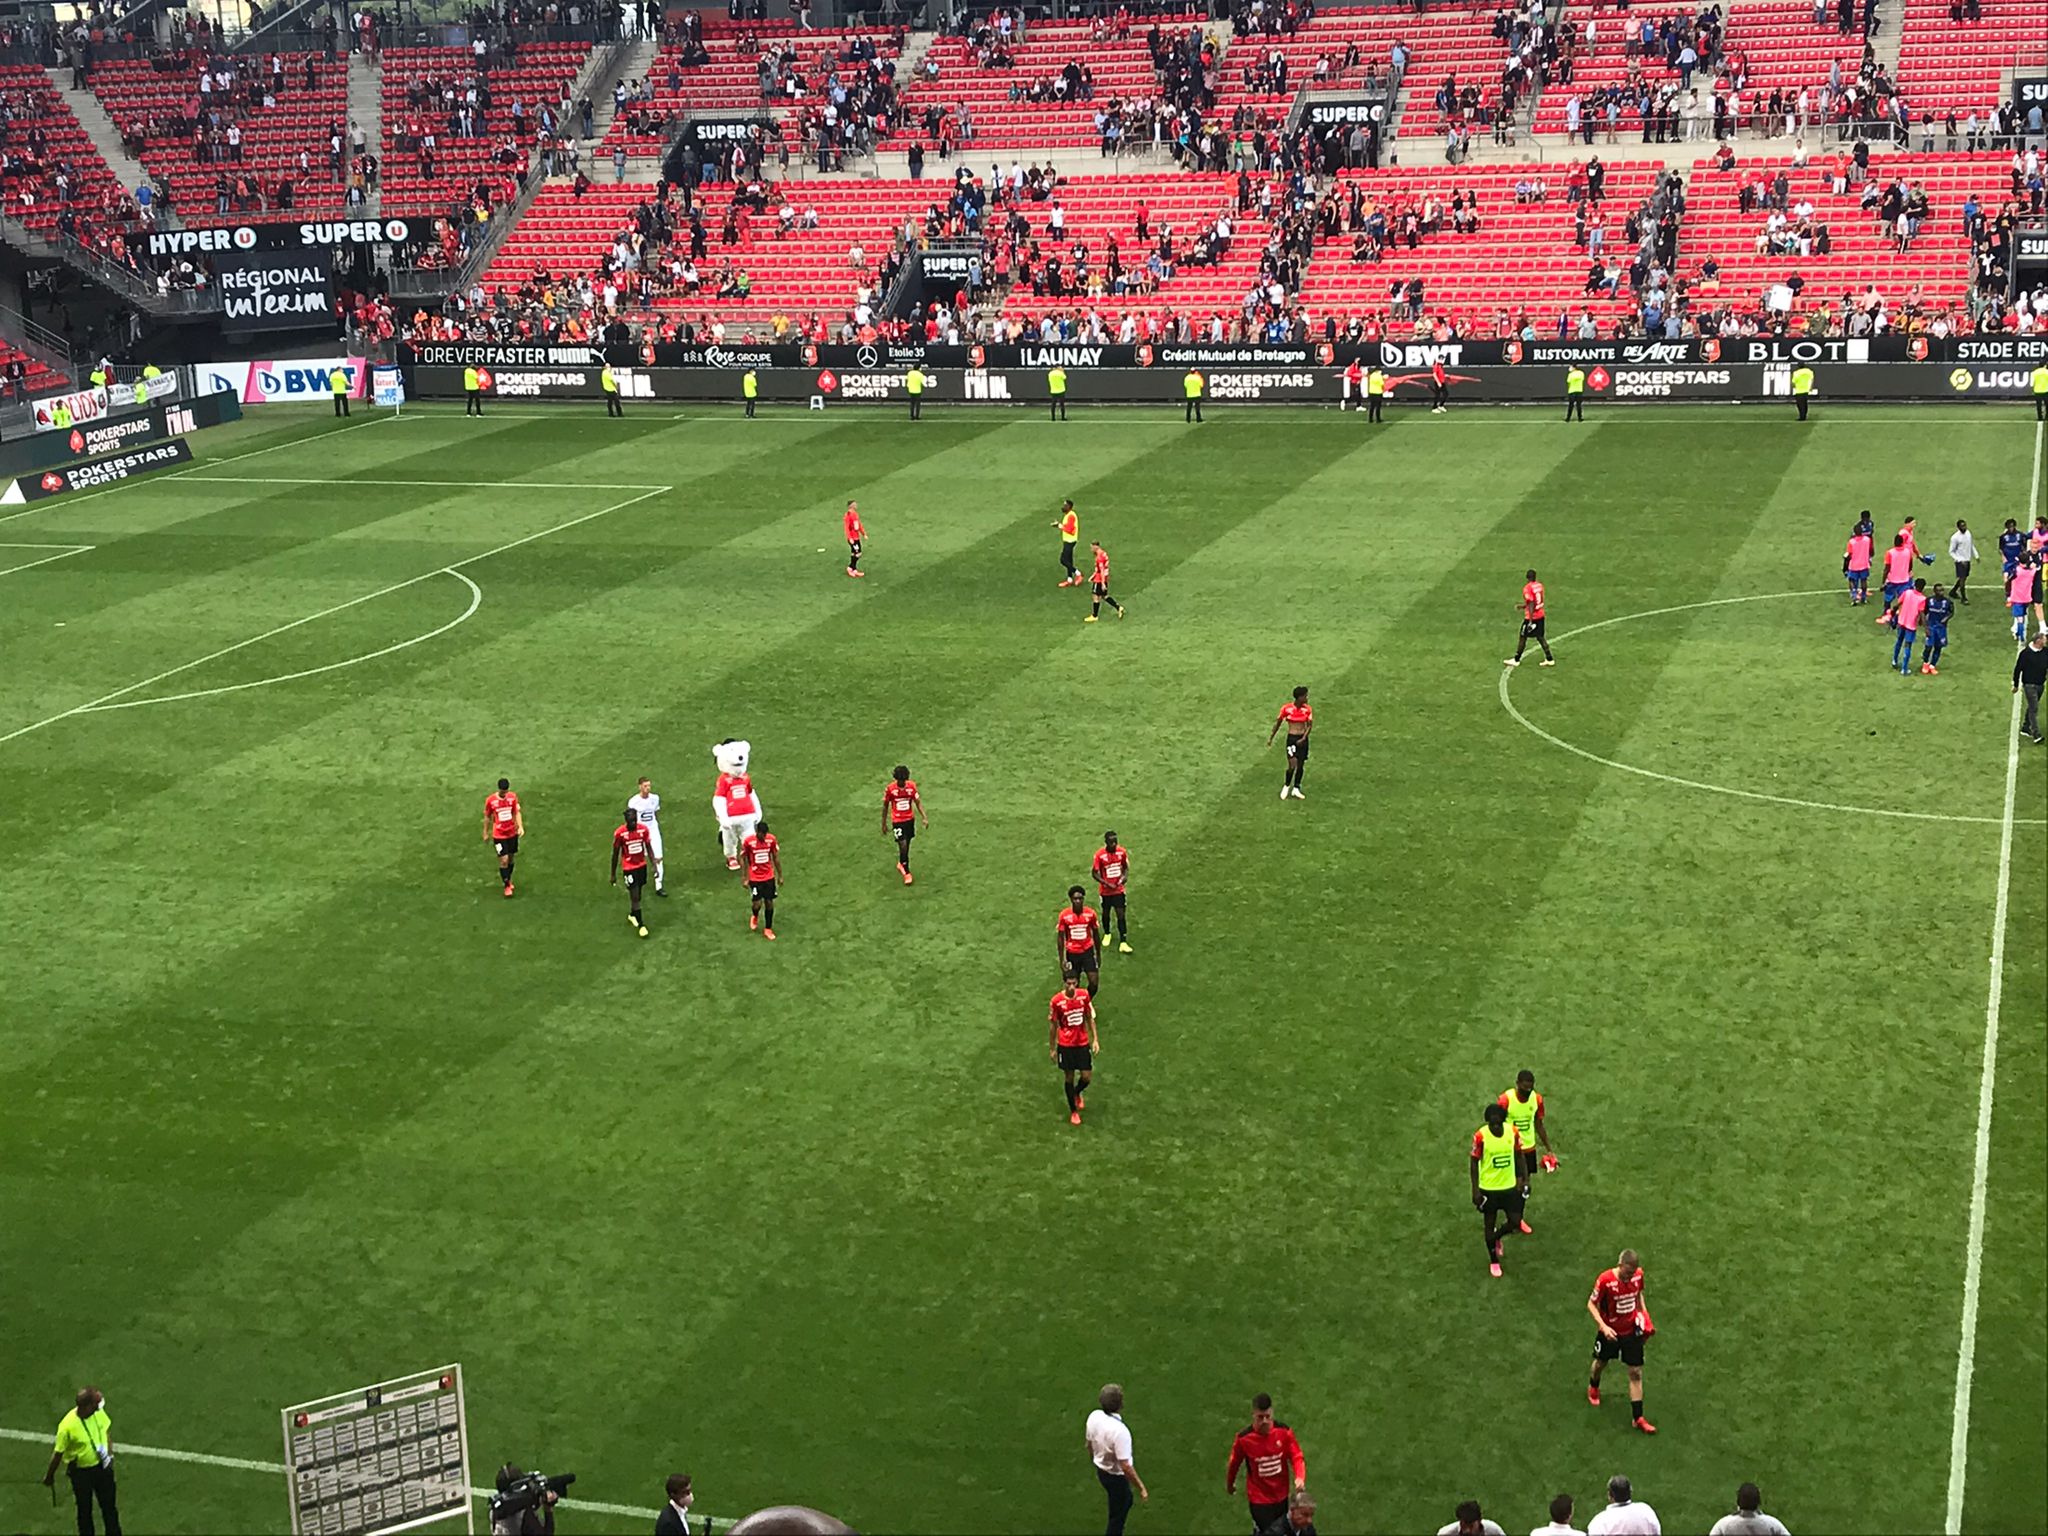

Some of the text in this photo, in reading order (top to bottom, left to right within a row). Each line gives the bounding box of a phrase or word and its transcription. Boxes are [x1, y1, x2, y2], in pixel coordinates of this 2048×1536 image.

[1312, 106, 1369, 123] SUPER
[696, 124, 747, 139] SUPER
[300, 221, 382, 245] SUPER
[150, 229, 231, 255] HYPER
[2021, 239, 2048, 254] SU
[923, 257, 967, 271] SUPER
[222, 265, 326, 289] RÉGIONAL
[224, 282, 328, 319] interim
[737, 352, 772, 362] GROUPE
[1162, 349, 1306, 364] Crédit Mutuel de Bretagne
[1405, 344, 1463, 366] BWT
[1533, 348, 1616, 361] RISTORANTE
[1748, 341, 1846, 361] BLOT
[1957, 341, 2014, 358] STADE
[495, 372, 586, 386] POKERSTARS
[841, 374, 937, 388] POKERSTRS
[1209, 374, 1314, 388] POKERSTARS
[1615, 370, 1730, 384] POKERSTARS
[496, 385, 541, 396] SPORTS
[841, 387, 889, 398] SPORTS
[1209, 387, 1260, 398] SPORTS
[1615, 384, 1671, 396] SPORTS
[85, 417, 150, 444] POKERSTARS
[87, 439, 121, 455] SPORTS
[66, 445, 179, 482] POKERSTARS
[70, 469, 128, 491] SPORTS
